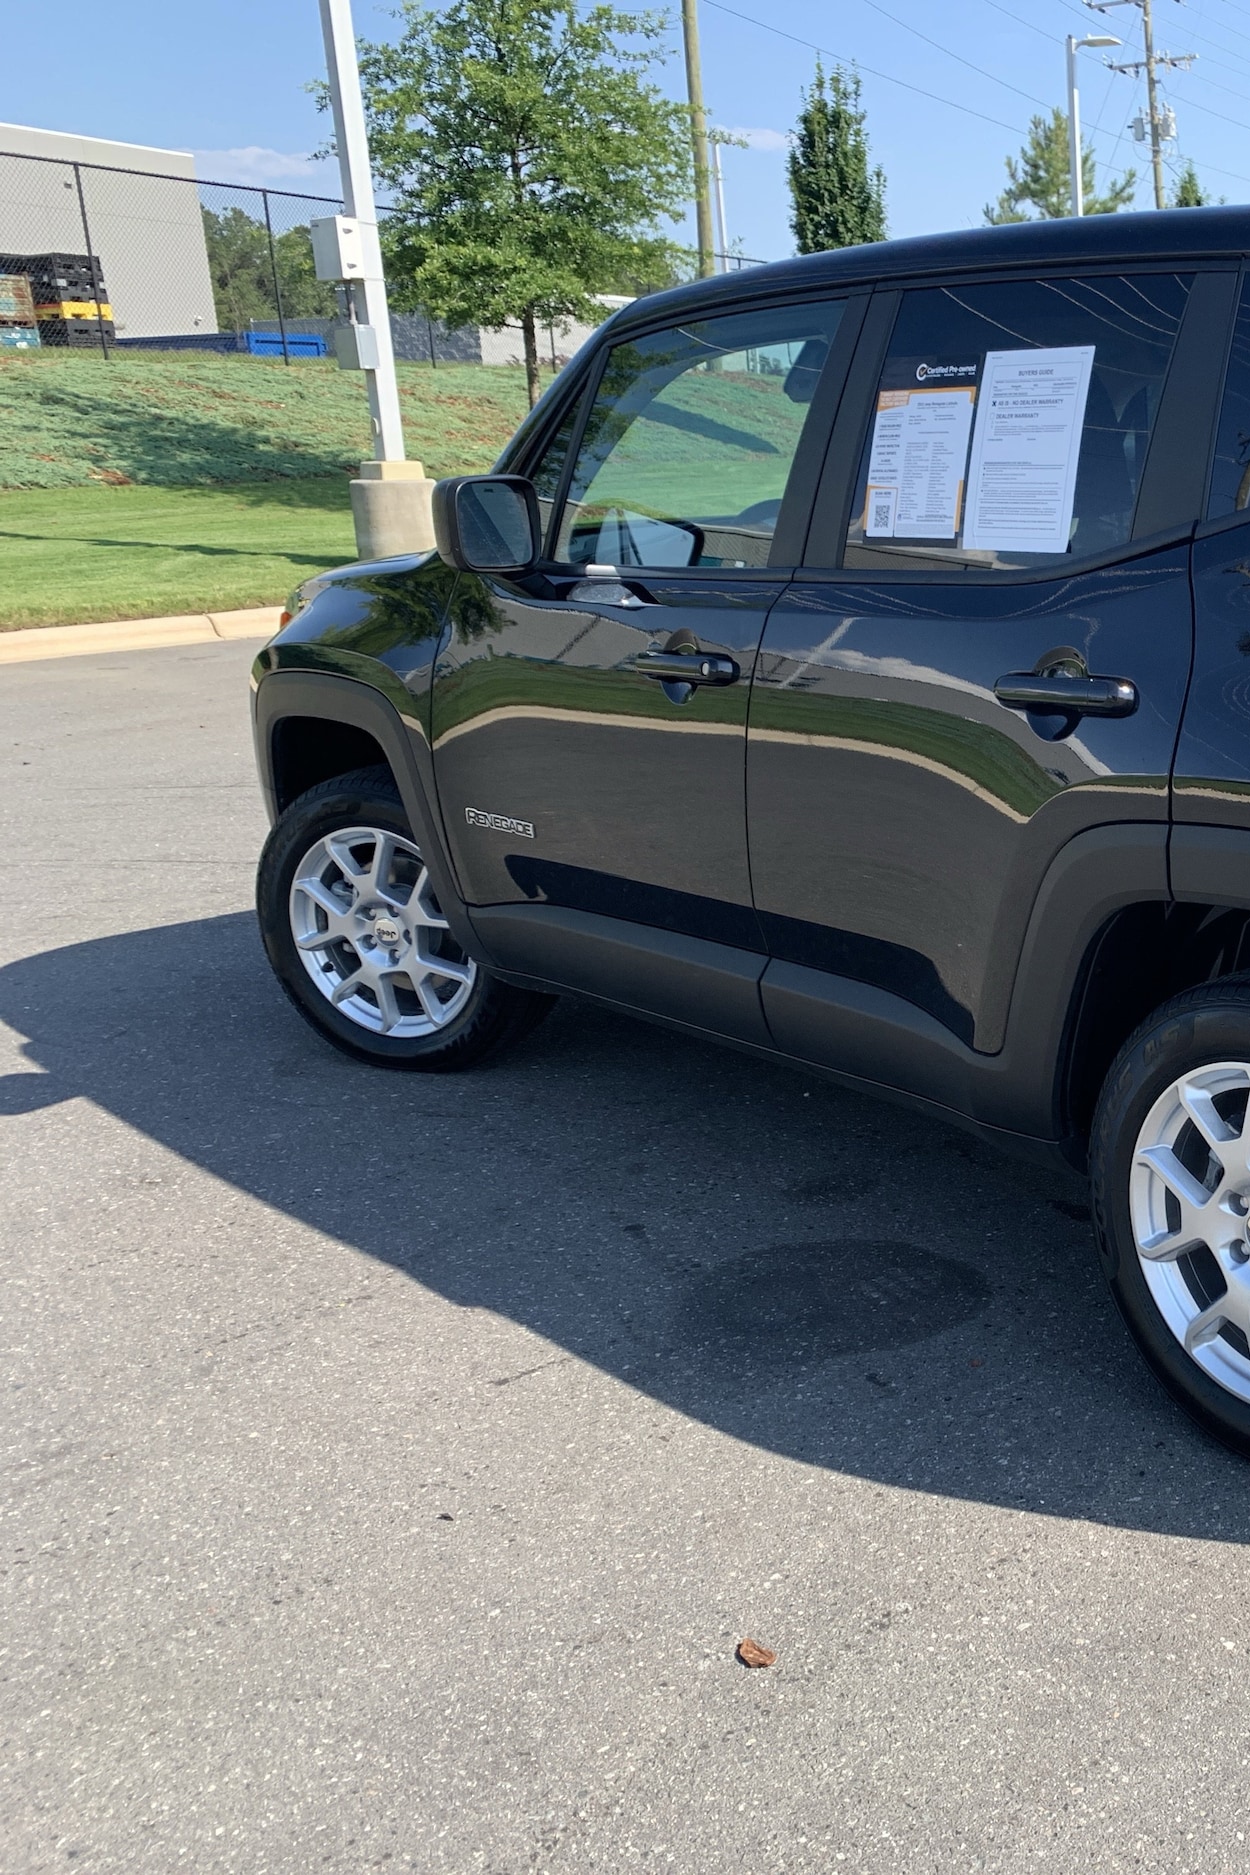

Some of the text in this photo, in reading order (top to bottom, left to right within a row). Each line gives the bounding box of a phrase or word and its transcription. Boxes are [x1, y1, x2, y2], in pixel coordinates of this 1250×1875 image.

[927, 366, 949, 375] Certified
[465, 807, 535, 839] RENEGADE
[376, 926, 397, 939] Jeep
